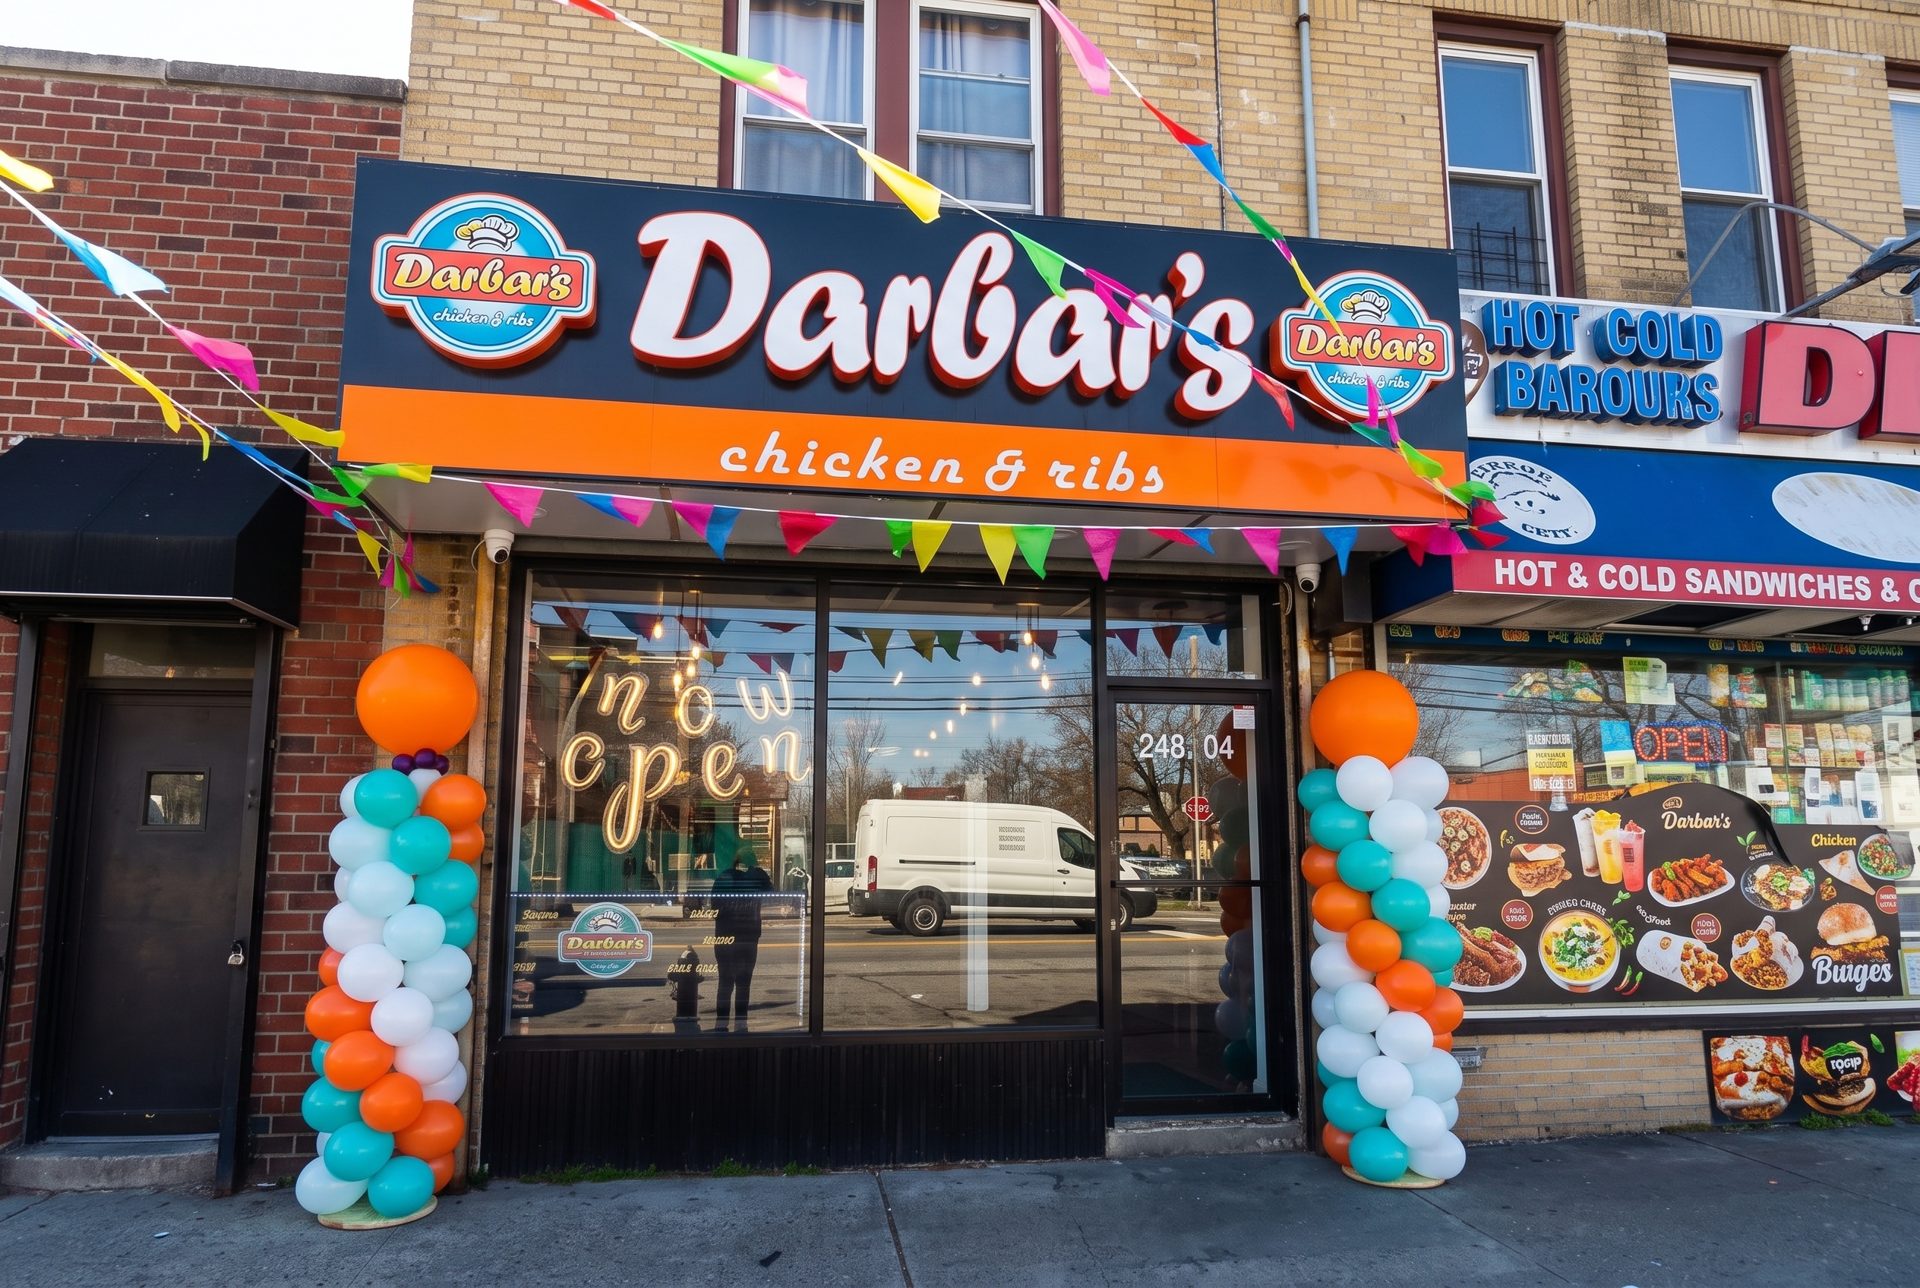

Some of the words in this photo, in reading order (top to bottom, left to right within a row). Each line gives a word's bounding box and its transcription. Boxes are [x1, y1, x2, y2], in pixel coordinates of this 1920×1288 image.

[392, 253, 573, 301] Darbar's
[433, 308, 488, 325] chicken
[506, 311, 535, 327] ribs
[631, 211, 1253, 416] Darbar's
[1490, 299, 1580, 352] HOT
[1606, 307, 1724, 362] COLD
[1296, 324, 1437, 366] Darbar's
[1327, 371, 1372, 387] chicke
[1388, 376, 1411, 389] ribs
[1507, 360, 1721, 422] BAROURS
[719, 430, 964, 484] chicken
[984, 449, 1026, 492] &
[1047, 451, 1164, 494] ribs
[1495, 558, 1557, 587] HOT
[1567, 562, 1589, 589] &
[1598, 563, 1676, 592] COLD
[1685, 567, 1872, 602] SANDWICHES
[1880, 577, 1900, 603] &
[1139, 733, 1186, 759] 248
[1203, 734, 1235, 760] 04
[1661, 811, 1732, 830] Darbar's
[1811, 833, 1857, 848] Chicken
[567, 936, 645, 950] Darbar's
